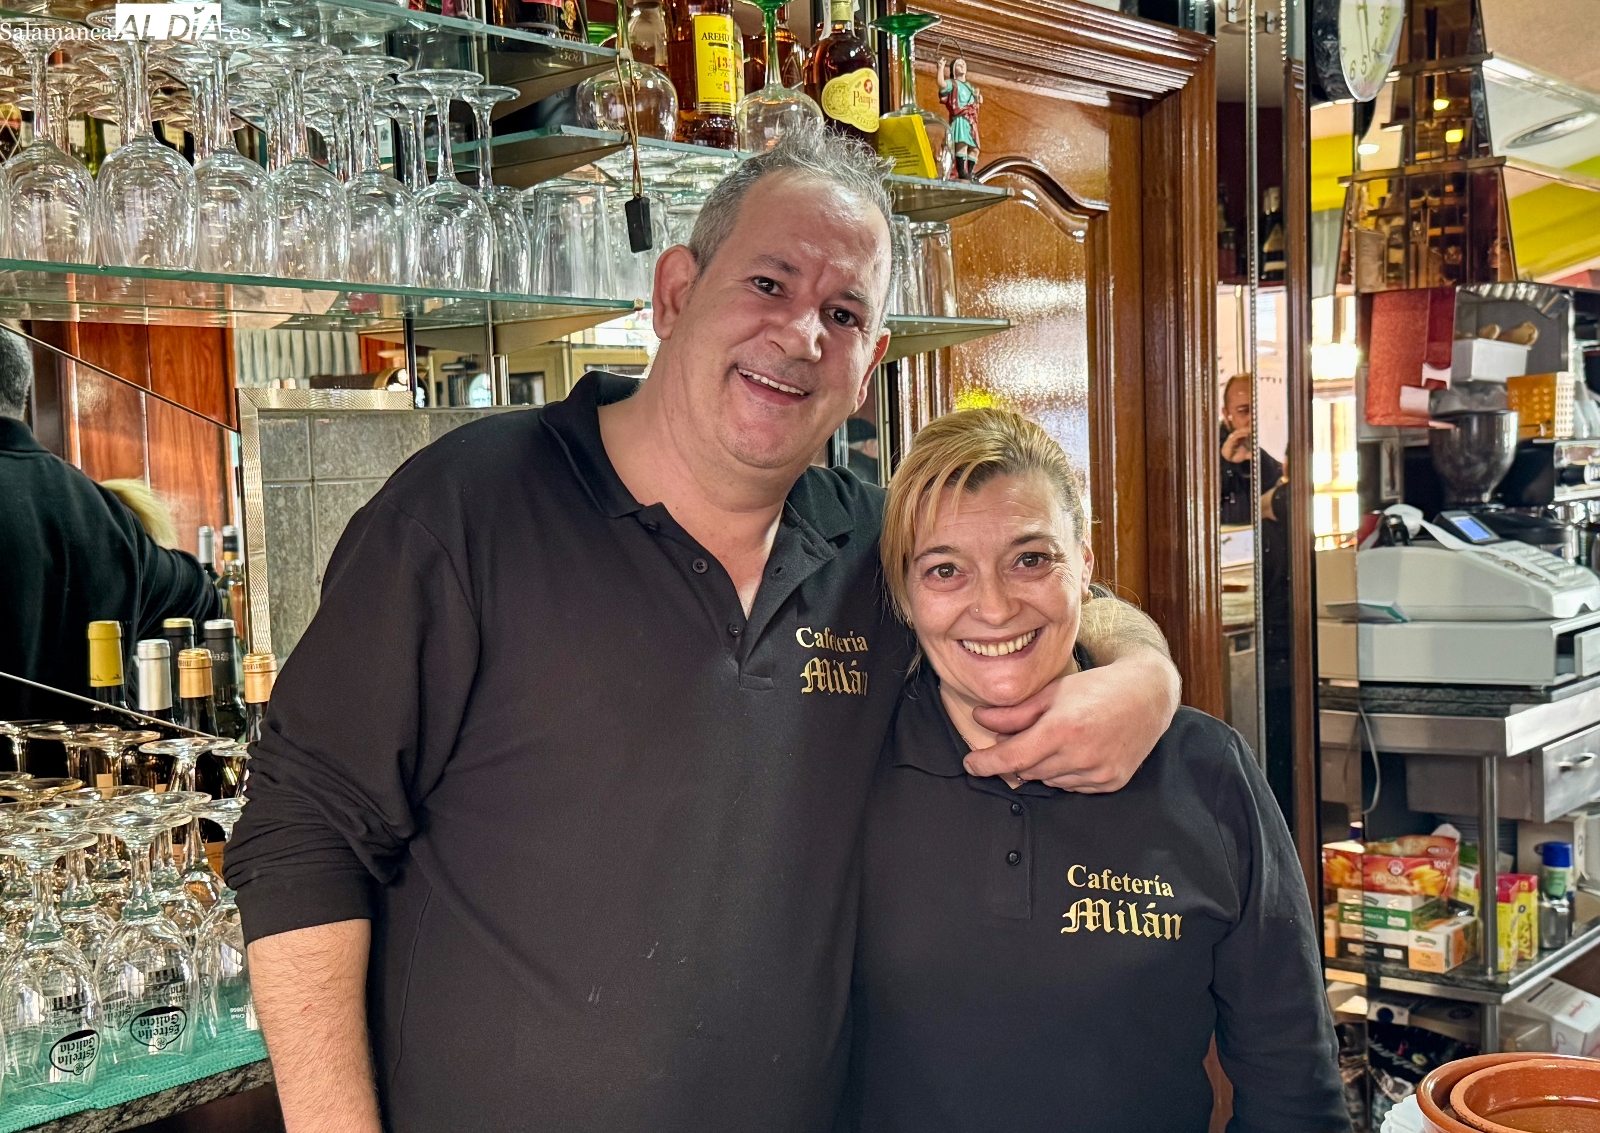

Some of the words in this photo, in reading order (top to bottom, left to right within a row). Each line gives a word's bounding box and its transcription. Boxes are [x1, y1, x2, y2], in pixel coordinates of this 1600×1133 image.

[1349, 60, 1357, 81] 6
[799, 656, 869, 697] Milán
[1067, 864, 1175, 898] Cafetería
[1060, 897, 1183, 941] Milán
[138, 1012, 180, 1030] Galicia
[137, 1023, 181, 1040] Estrella
[60, 1036, 96, 1055] Galicia
[57, 1046, 95, 1066] Estrella
